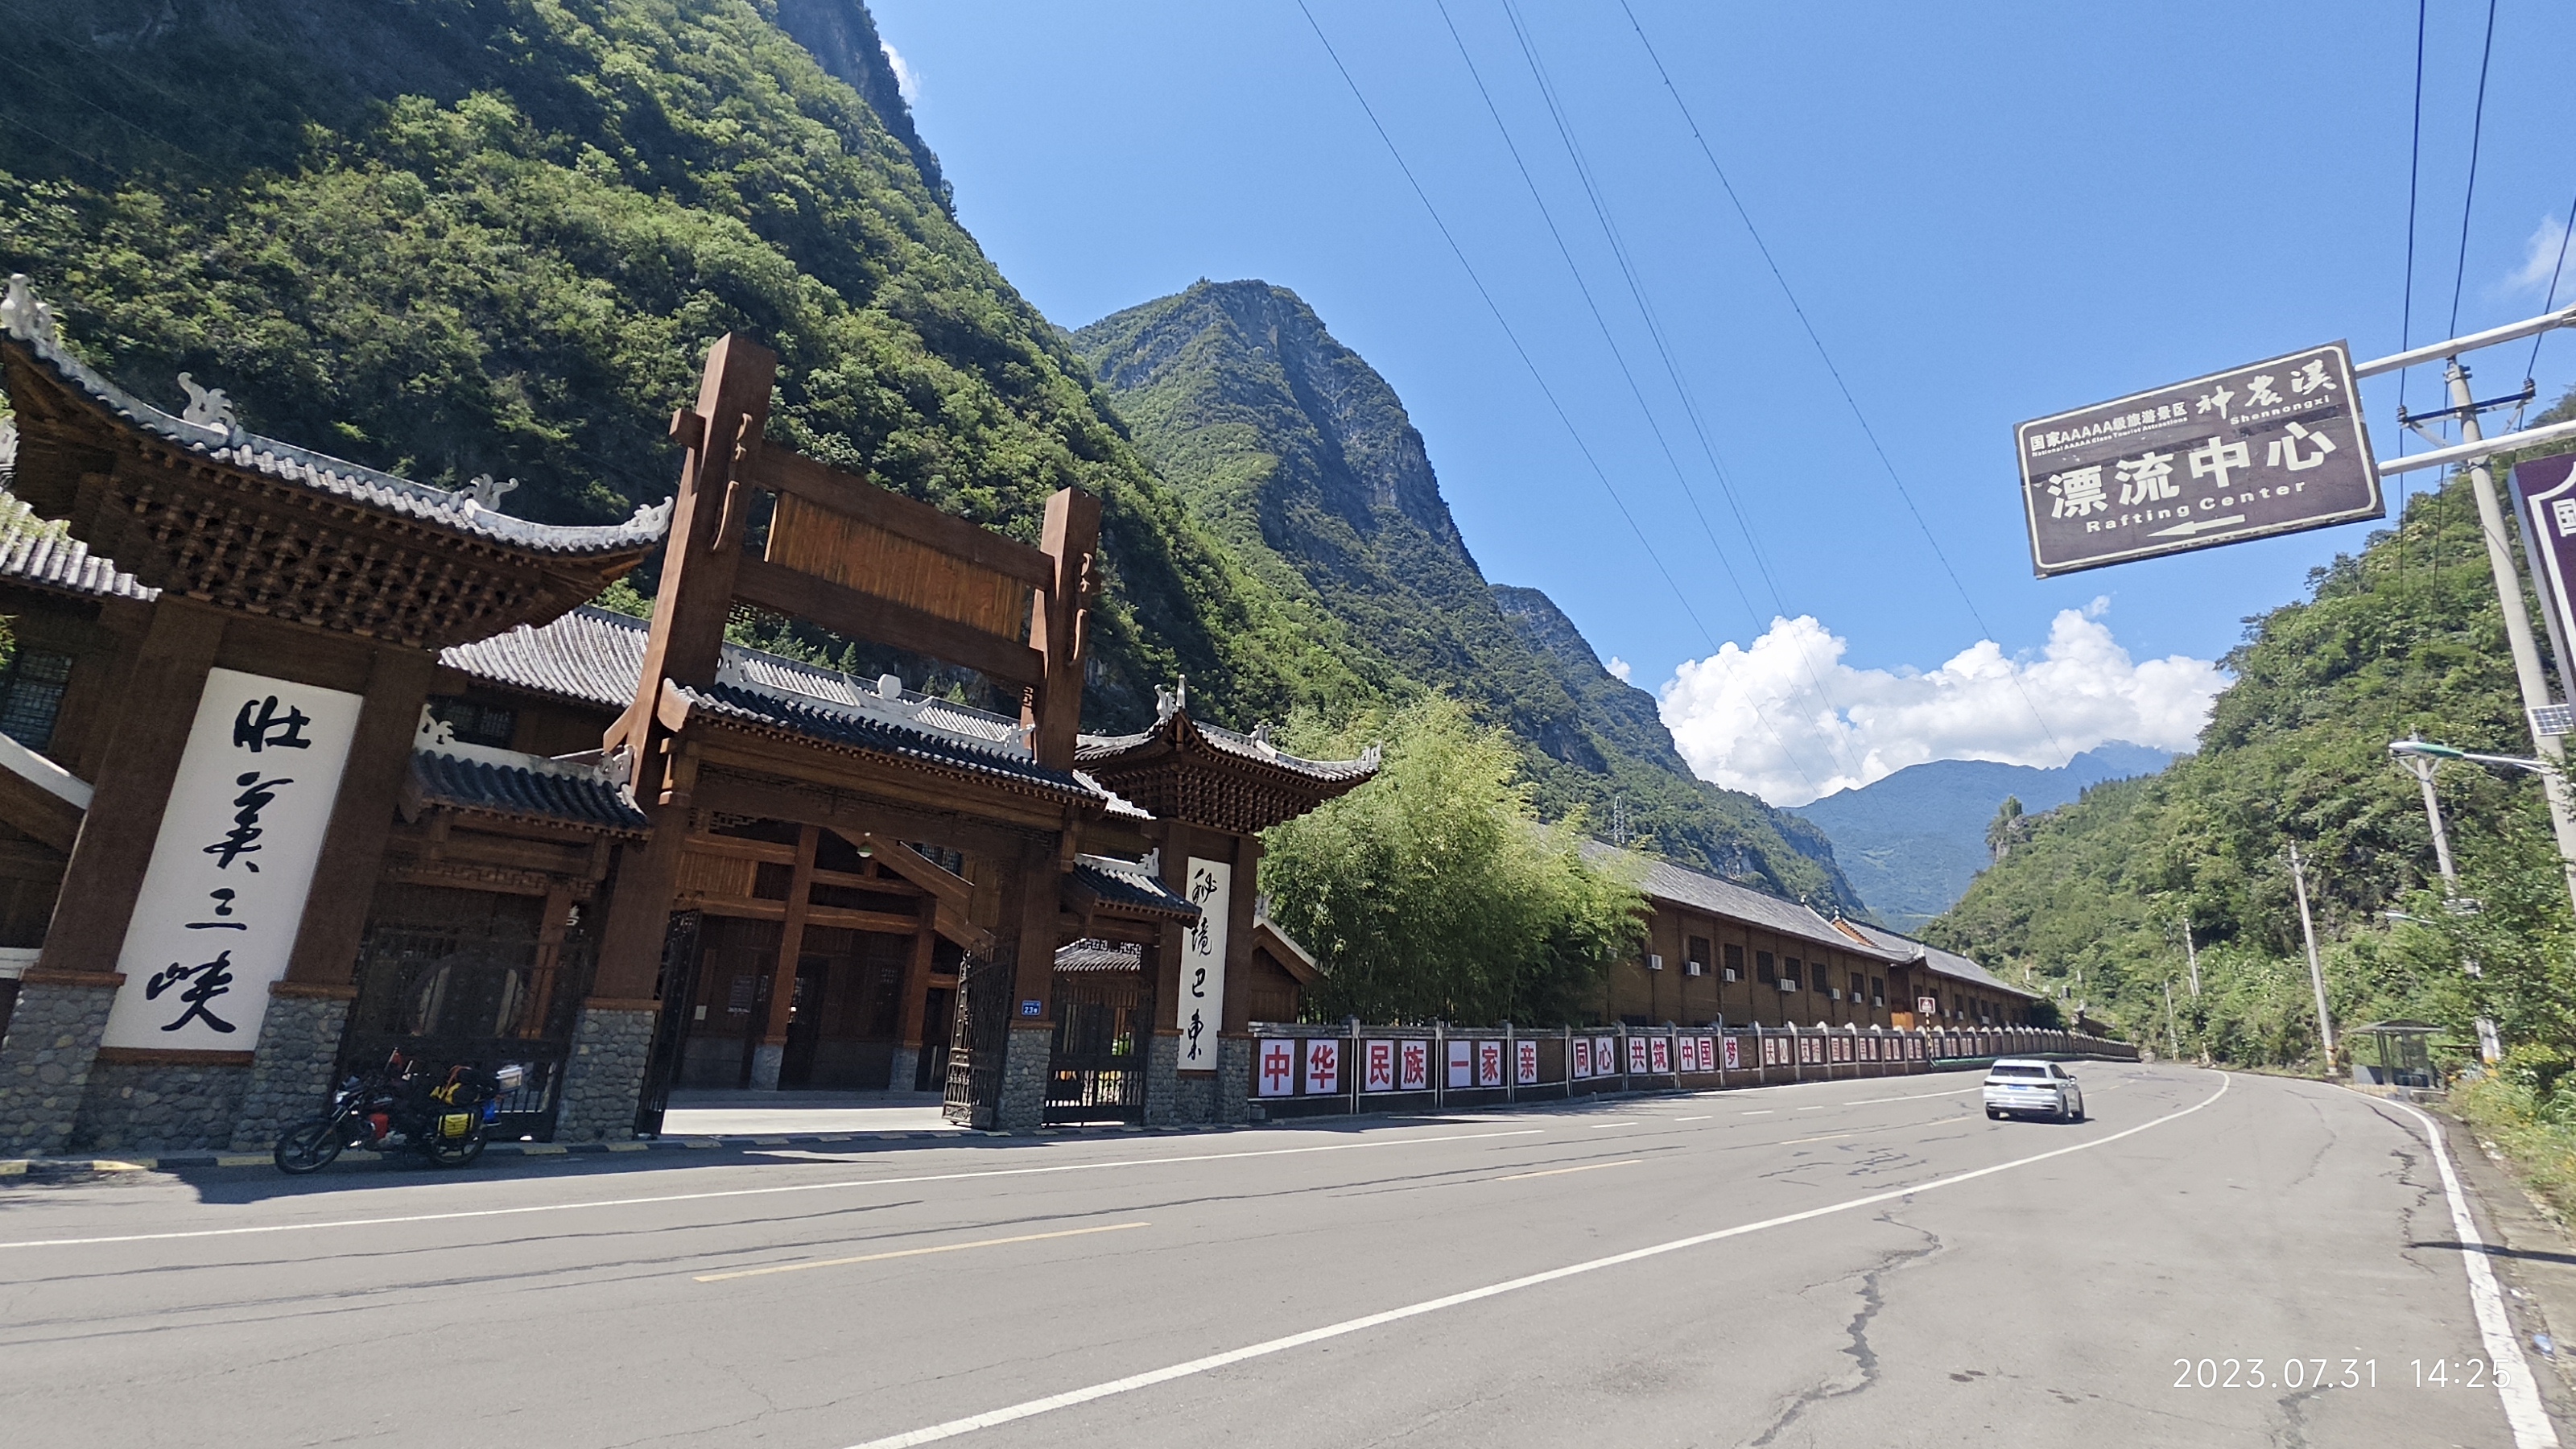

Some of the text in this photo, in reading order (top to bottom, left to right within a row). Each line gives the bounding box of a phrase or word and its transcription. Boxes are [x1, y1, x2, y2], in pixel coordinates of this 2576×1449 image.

[2029, 401, 2188, 451] 国家AAAAA级旅游景区
[2229, 394, 2330, 425] Shennongxi
[2031, 416, 2188, 457] National AAAAA Class Tourist Attractions
[2047, 421, 2338, 519] 漂流中心
[2085, 481, 2307, 534] Rafting Center
[1264, 1044, 1535, 1092] 中华民族一家亲
[1575, 1038, 1738, 1077] 同心共筑中国梦
